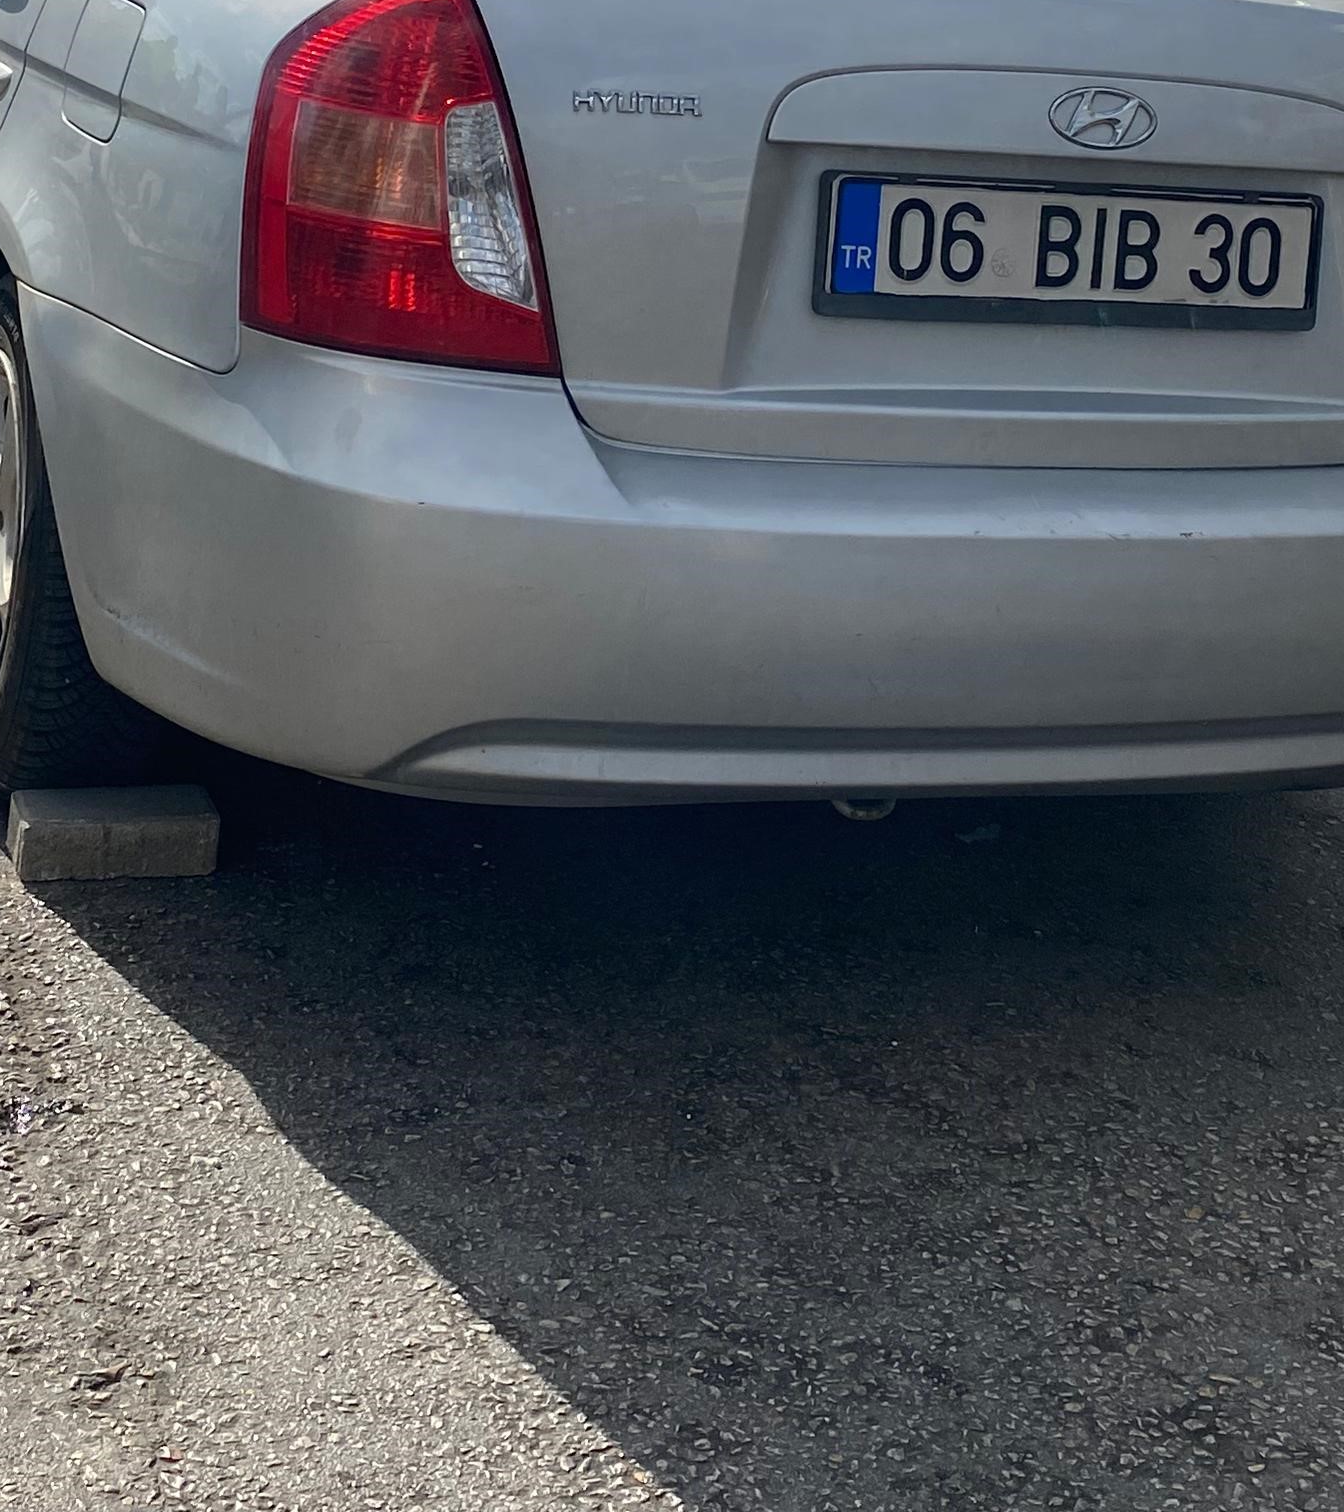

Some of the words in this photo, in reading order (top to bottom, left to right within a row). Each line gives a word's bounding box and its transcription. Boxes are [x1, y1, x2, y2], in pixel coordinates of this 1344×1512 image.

[841, 245, 873, 270] TR
[888, 197, 986, 283] 06
[1035, 204, 1161, 291] BIB
[1188, 213, 1282, 297] 30
